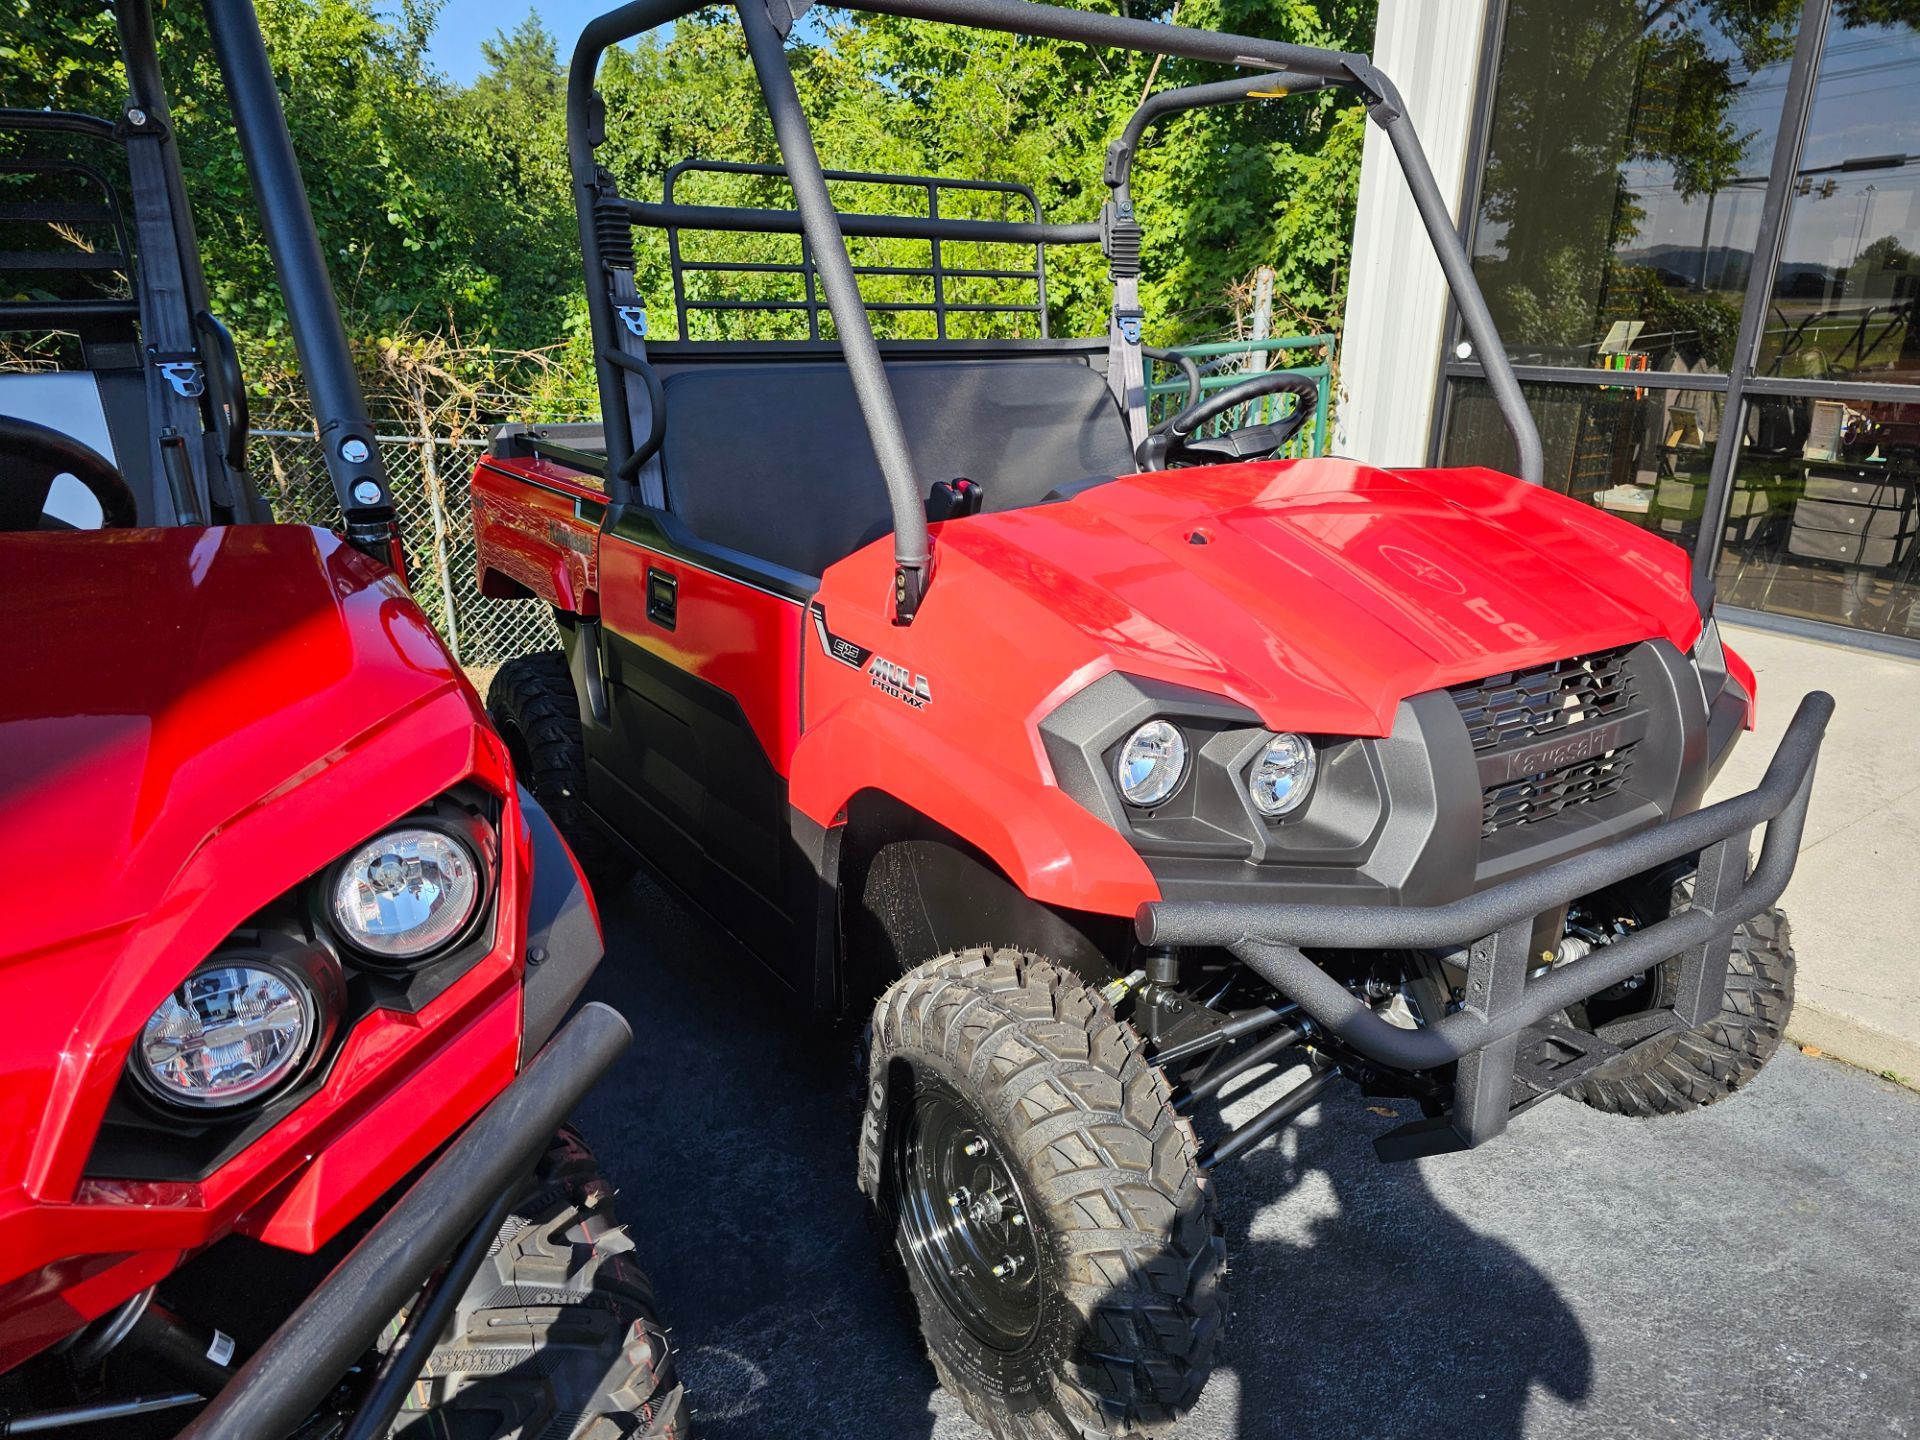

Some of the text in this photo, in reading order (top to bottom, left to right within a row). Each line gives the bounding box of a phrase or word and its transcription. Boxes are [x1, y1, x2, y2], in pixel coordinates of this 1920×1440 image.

[834, 639, 859, 658] EPS
[867, 656, 932, 704] MULE
[1506, 727, 1608, 780] Kawasaki
